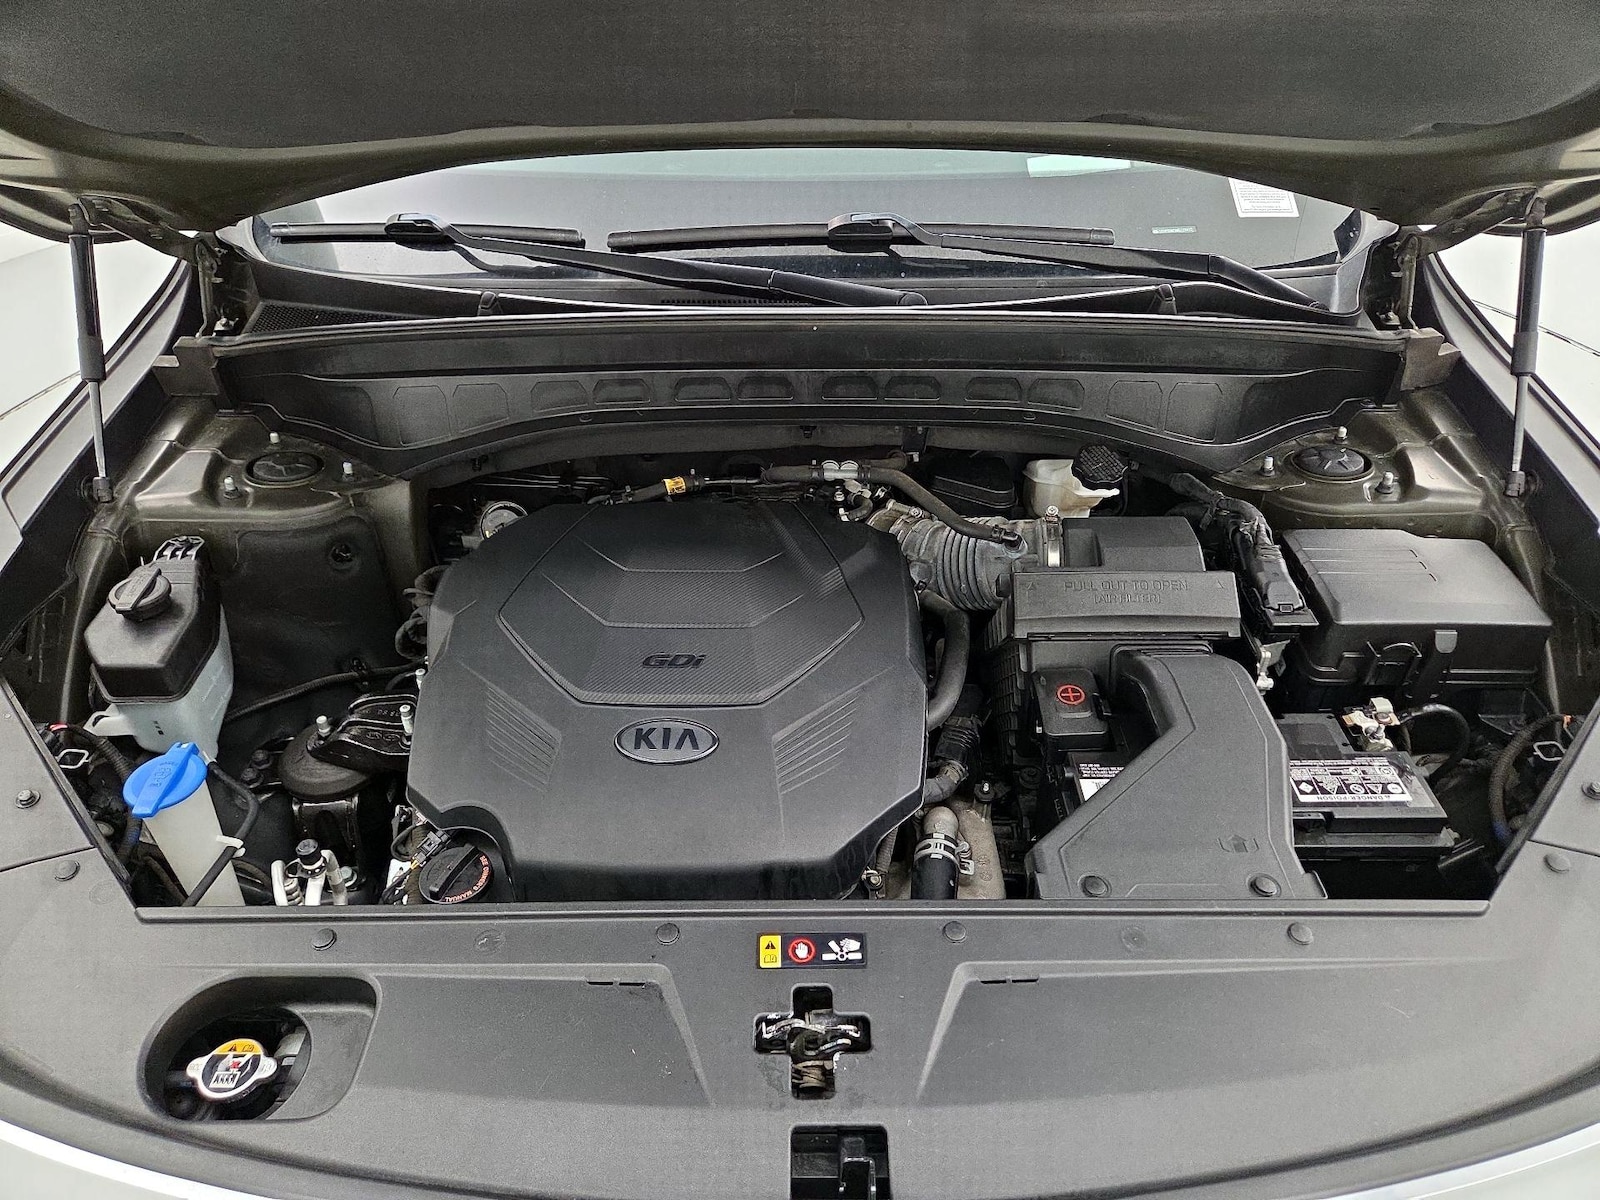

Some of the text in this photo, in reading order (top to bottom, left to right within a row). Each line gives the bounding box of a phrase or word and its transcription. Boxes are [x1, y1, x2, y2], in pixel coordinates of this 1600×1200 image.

[1063, 579, 1188, 592] PULL OUT TO OPEN
[642, 653, 706, 669] GDi
[634, 727, 700, 751] KIA
[445, 890, 472, 902] MANUAL
